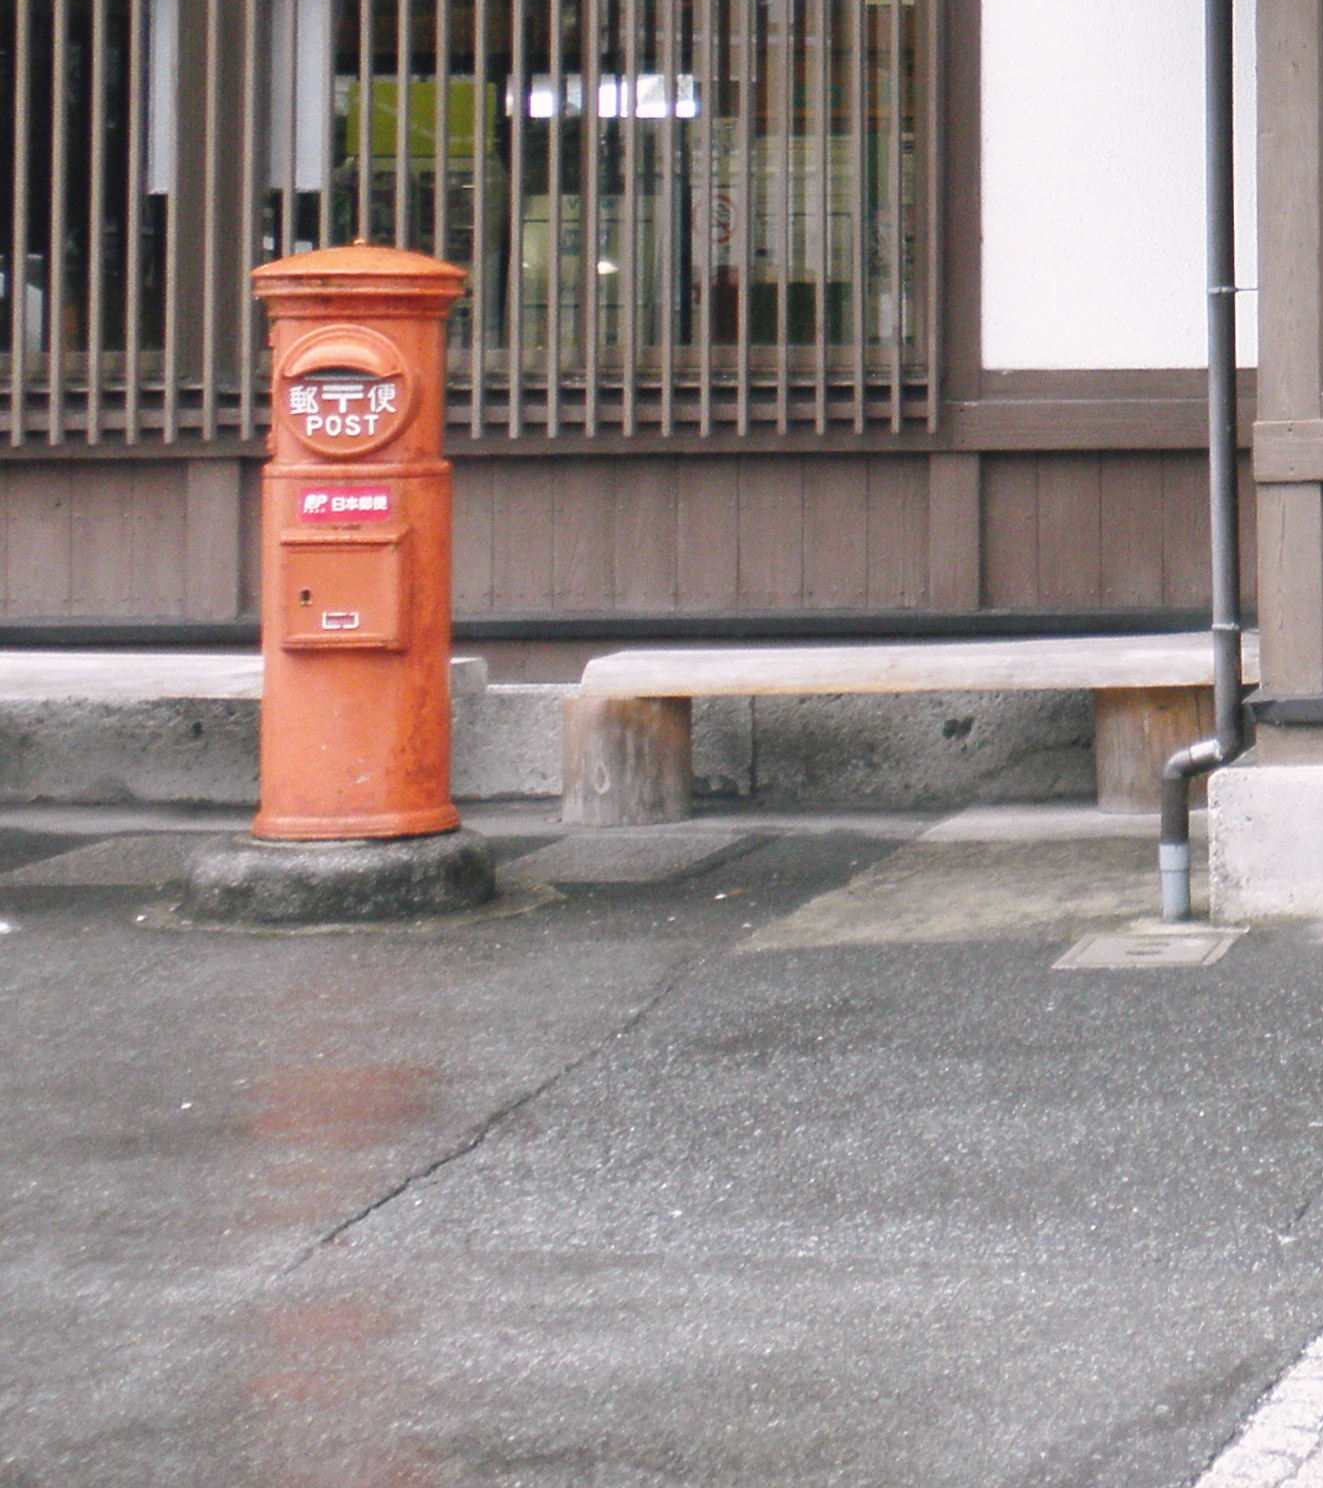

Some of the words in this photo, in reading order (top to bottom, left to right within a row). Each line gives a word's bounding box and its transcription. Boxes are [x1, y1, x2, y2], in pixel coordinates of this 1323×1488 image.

[306, 415, 380, 437] POST
[331, 495, 389, 512] 日本郵便
